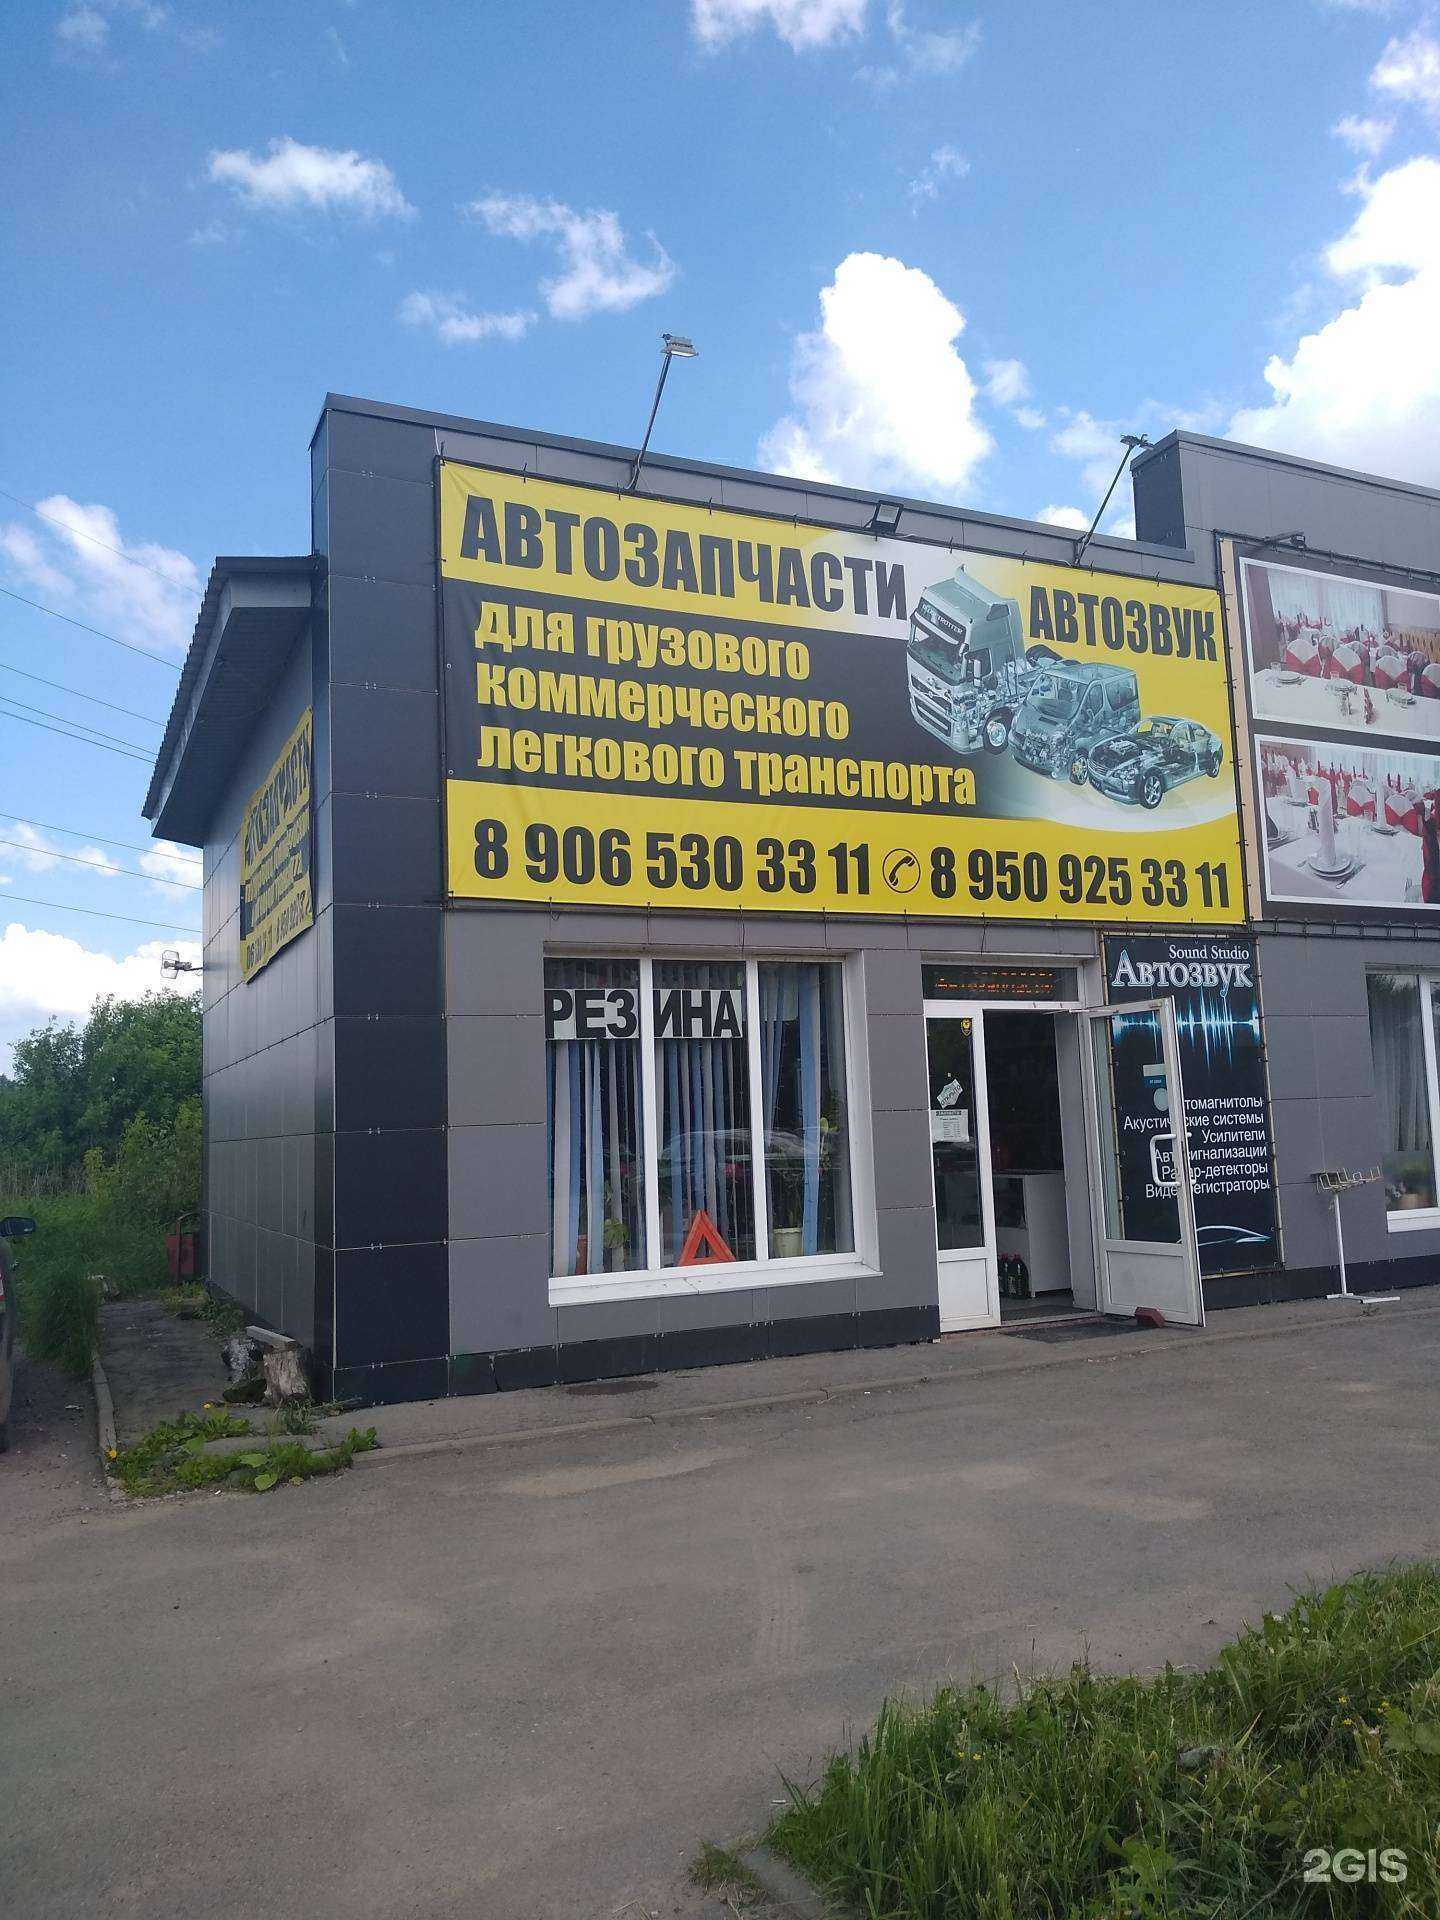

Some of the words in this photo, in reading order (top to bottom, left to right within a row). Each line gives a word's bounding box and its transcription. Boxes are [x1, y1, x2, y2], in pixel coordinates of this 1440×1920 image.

[459, 494, 907, 621] АВТОЗАПЧАСТИ
[474, 601, 575, 654] для
[586, 616, 810, 680] грузового
[1029, 585, 1218, 662] АВТОЗВУК
[476, 662, 849, 740] коммерческого
[476, 726, 725, 788] легкового
[733, 750, 977, 806] транспорта
[473, 818, 509, 880] 8
[524, 822, 632, 887] 906
[645, 832, 743, 891] 530
[756, 838, 817, 894] 33
[827, 842, 870, 895] 11
[930, 846, 957, 899] 8
[968, 848, 1048, 903] 950
[1058, 853, 1132, 906] 925
[1140, 859, 1188, 908] 33
[1195, 862, 1230, 909] 11
[1169, 944, 1208, 959] Sound
[1211, 945, 1250, 960] Studio
[544, 989, 743, 1038] РЕЗИНА
[1184, 1096, 1263, 1110] томагнитолы
[1202, 1129, 1265, 1144] Усилители
[1213, 1113, 1264, 1126] системы
